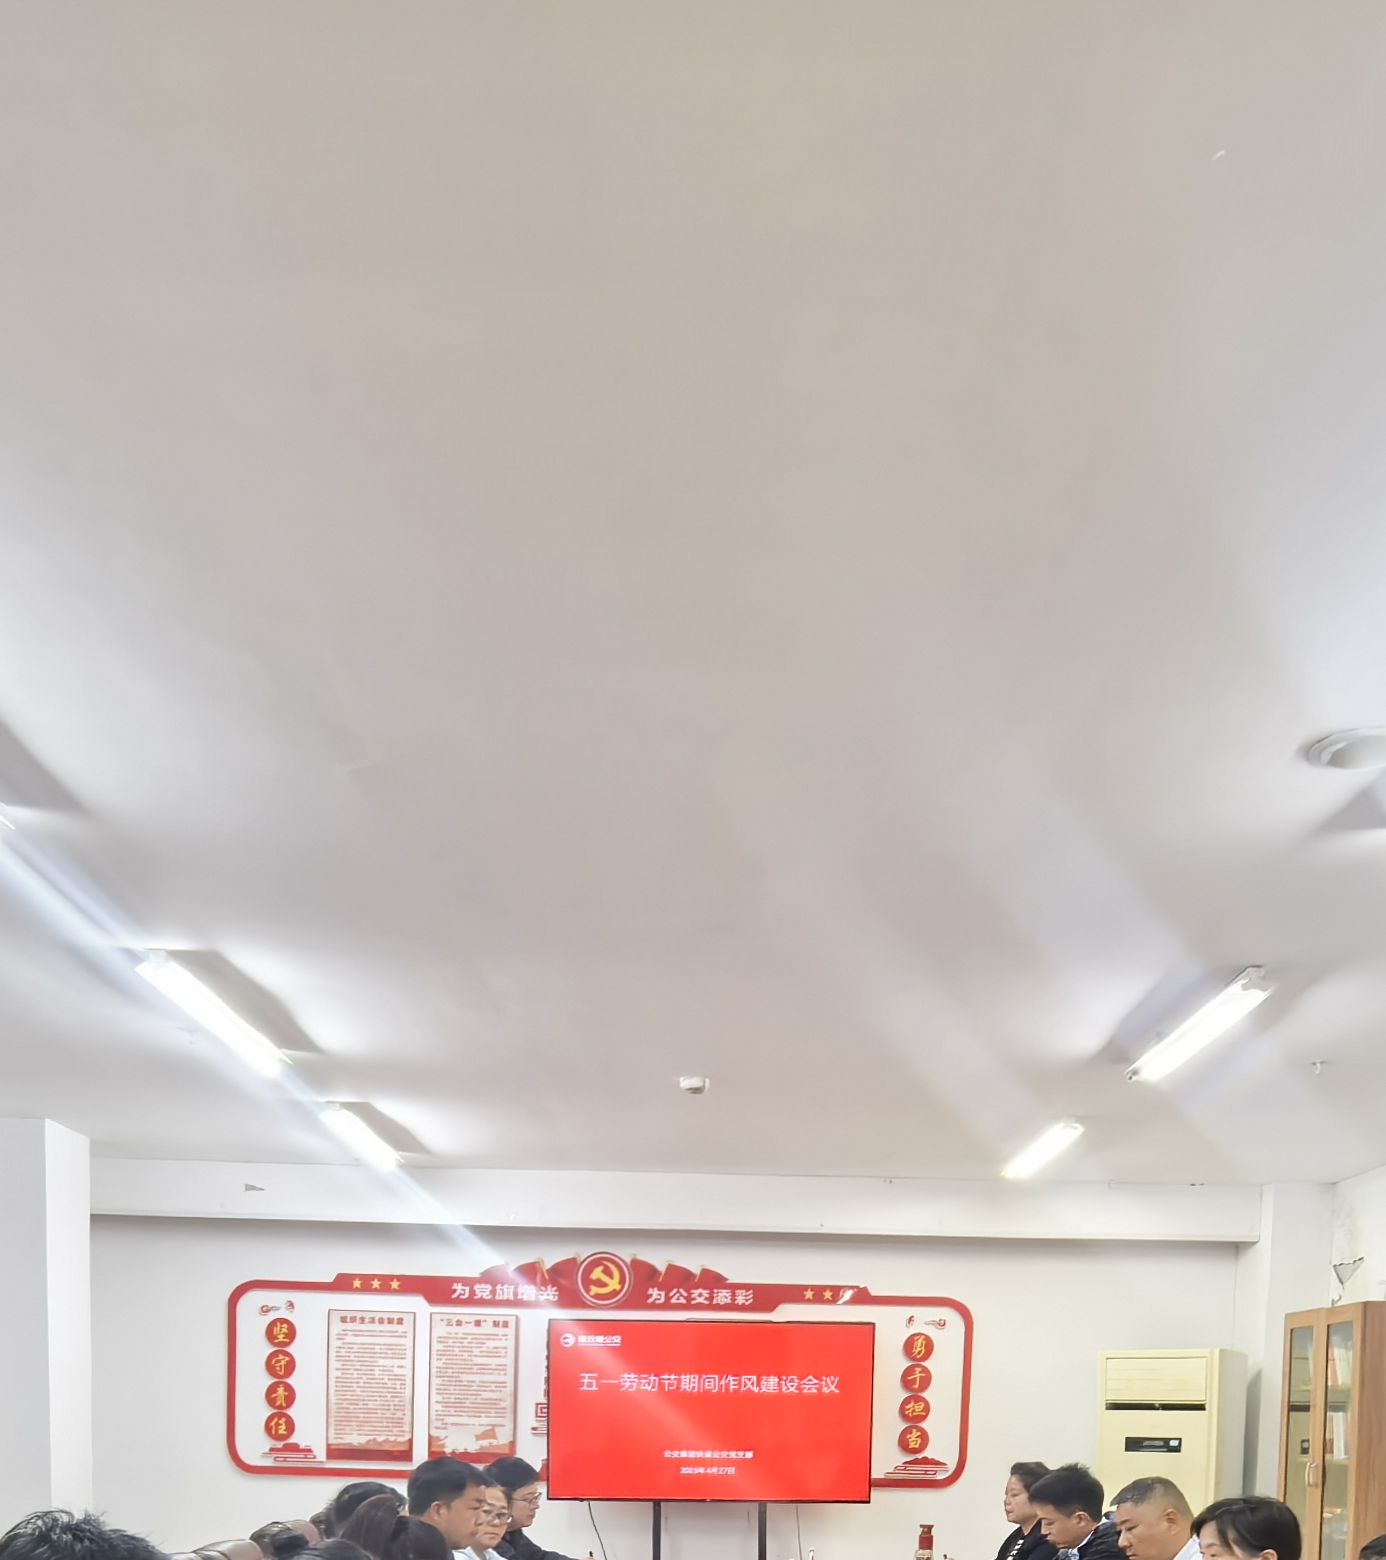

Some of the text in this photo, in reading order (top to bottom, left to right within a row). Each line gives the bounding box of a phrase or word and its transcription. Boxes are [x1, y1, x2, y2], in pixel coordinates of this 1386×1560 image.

[451, 1283, 559, 1302] 为党旗增光
[646, 1287, 754, 1306] 为公交添彩
[269, 1321, 291, 1436] 坚守责任
[579, 1372, 840, 1394] 五一劳动节期间作风建设会议
[904, 1334, 926, 1449] 勇于担当
